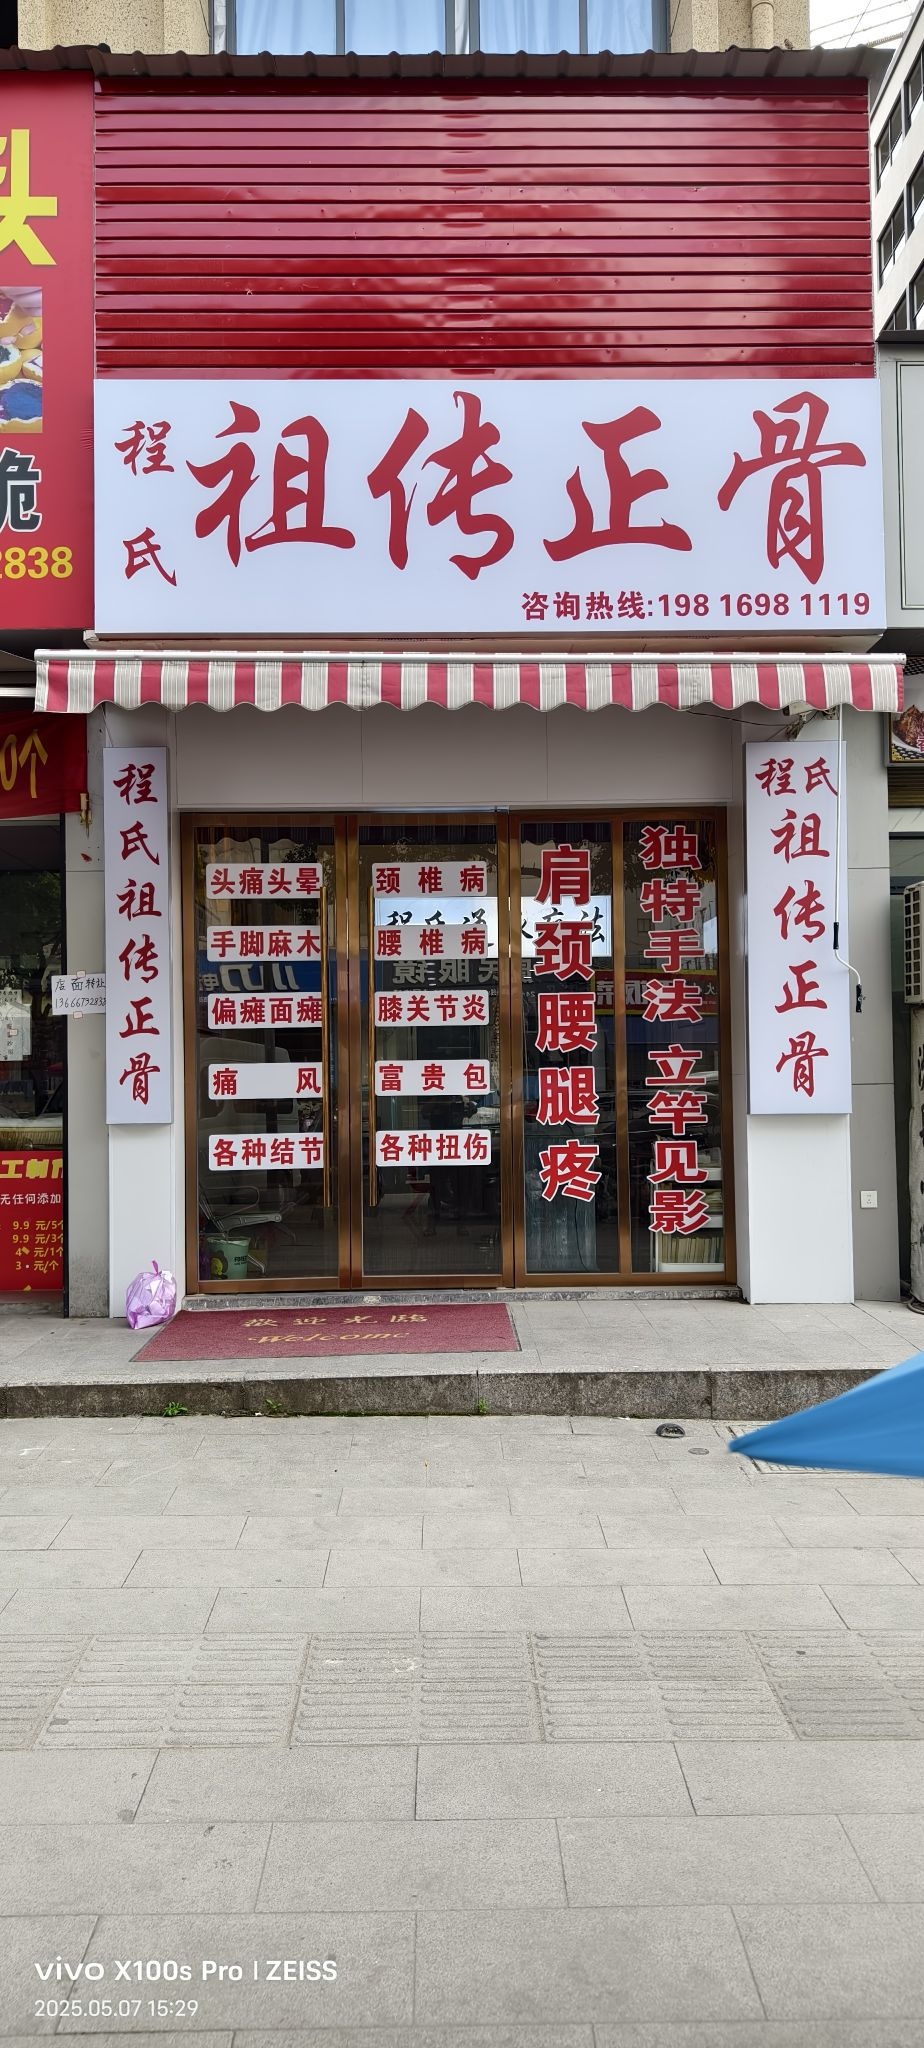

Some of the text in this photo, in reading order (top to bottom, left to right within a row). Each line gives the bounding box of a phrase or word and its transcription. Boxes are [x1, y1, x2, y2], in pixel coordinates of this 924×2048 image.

[187, 391, 867, 584] 祖传正骨
[113, 420, 178, 586] 程氏
[0, 546, 73, 579] 838
[723, 593, 788, 616] 1698
[803, 593, 869, 616] 1119
[755, 757, 838, 797] 程氏
[210, 867, 320, 895] 头痛头晕
[376, 865, 485, 893] 颈椎病
[113, 763, 162, 1105] 程氏祖传正骨
[210, 929, 319, 957] 手脚麻木
[377, 928, 486, 956] 腰椎病
[770, 808, 830, 1098] 祖传正骨
[211, 996, 322, 1026] 偏瘫面瘫
[377, 994, 486, 1023] 膝关节炎
[534, 843, 602, 1203] 肩颈腰腿疼
[640, 825, 712, 1236] 独特手法 立竿见影
[379, 1063, 488, 1092] 富贵包
[213, 1136, 323, 1167] 各种结节
[380, 1133, 488, 1163] 各种扭伤
[0, 1193, 61, 1205] 无任何添加
[12, 1221, 30, 1230] 9.9
[12, 1234, 29, 1244] 9.9
